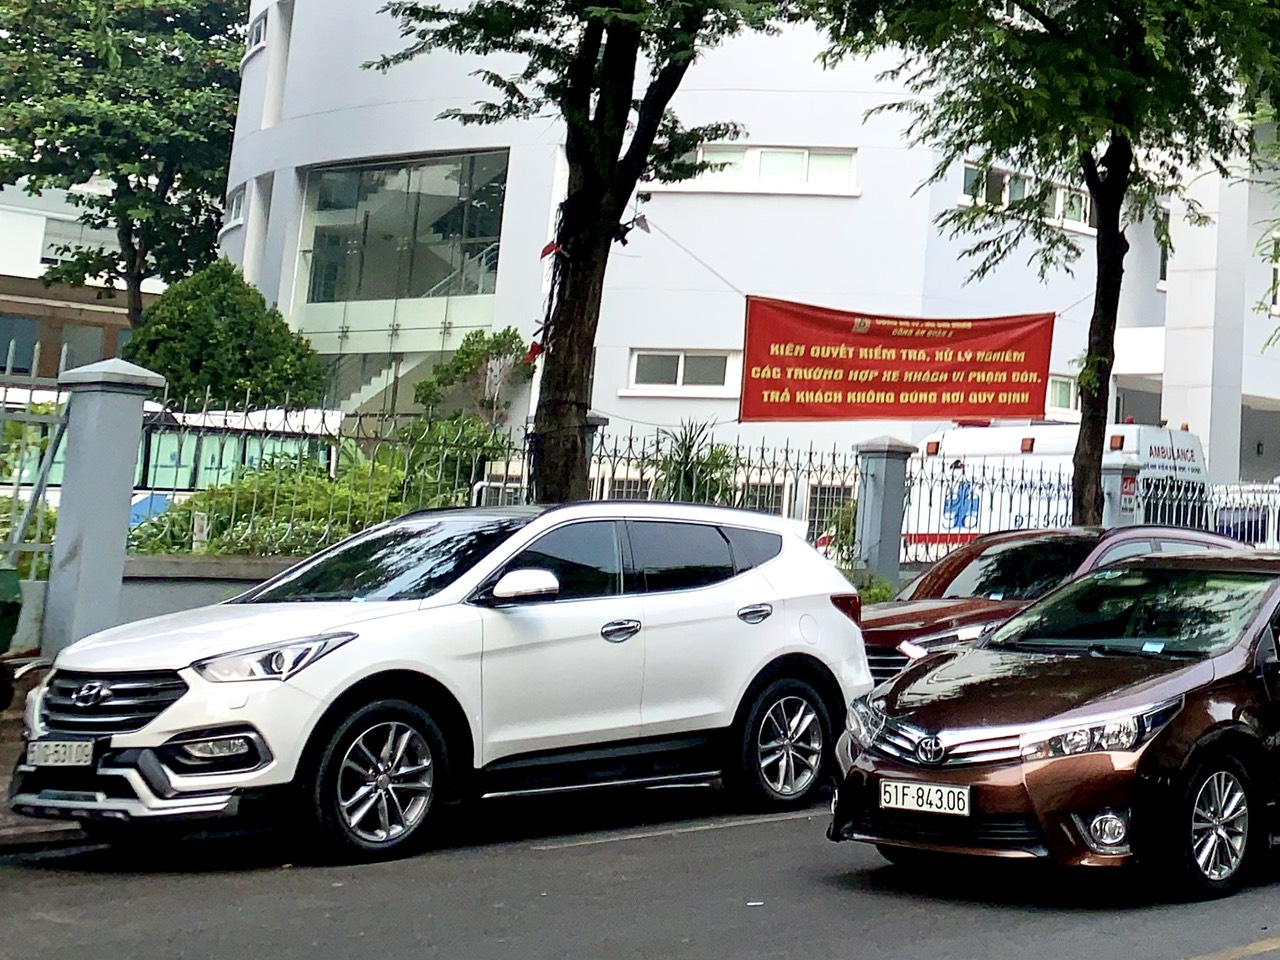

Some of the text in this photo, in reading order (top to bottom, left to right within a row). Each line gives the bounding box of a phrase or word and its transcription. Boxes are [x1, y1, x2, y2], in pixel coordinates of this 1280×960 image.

[751, 364, 781, 379] CÁC
[848, 369, 879, 383] HỢP
[882, 370, 900, 382] XE
[903, 370, 949, 383] KHÁCH
[952, 371, 964, 383] VI
[967, 371, 1007, 385] PHẠM
[762, 387, 791, 403] TRẢ
[795, 389, 843, 403] KHÁCH
[847, 389, 895, 403] KHÔNG
[968, 392, 995, 404] QUY
[998, 391, 1030, 405] ĐỊNH
[1149, 444, 1196, 463] AMBULANCE
[883, 783, 966, 811] 51F-843.06
